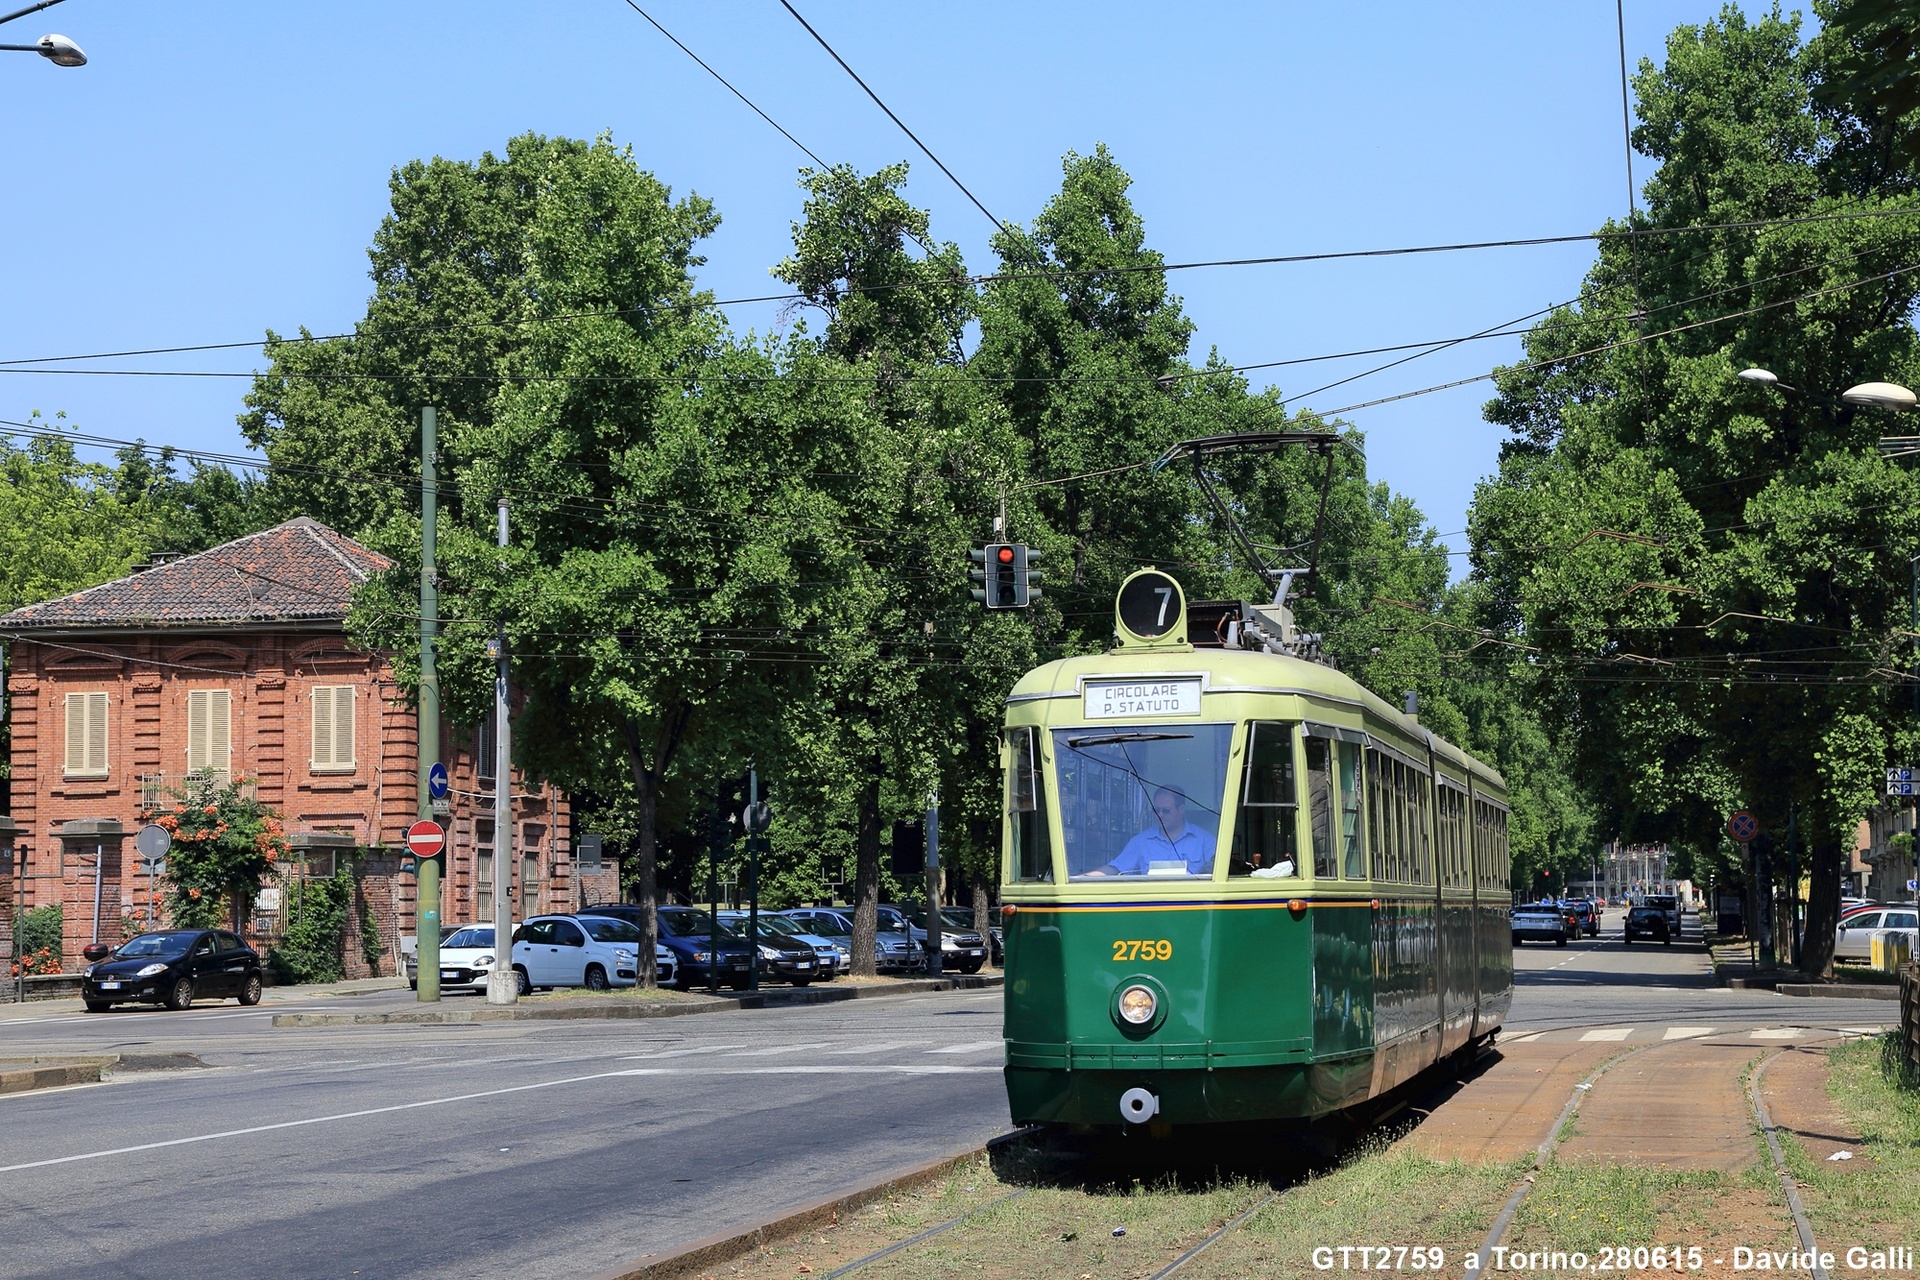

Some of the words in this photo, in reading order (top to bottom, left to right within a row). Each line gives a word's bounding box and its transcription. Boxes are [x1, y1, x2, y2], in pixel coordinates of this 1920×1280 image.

[1154, 587, 1172, 626] 7
[1105, 684, 1178, 700] CIRCOLARE
[1104, 703, 1115, 714] P.
[1119, 699, 1179, 713] STATUTO
[1902, 784, 1910, 794] P
[1112, 939, 1173, 961] 2759
